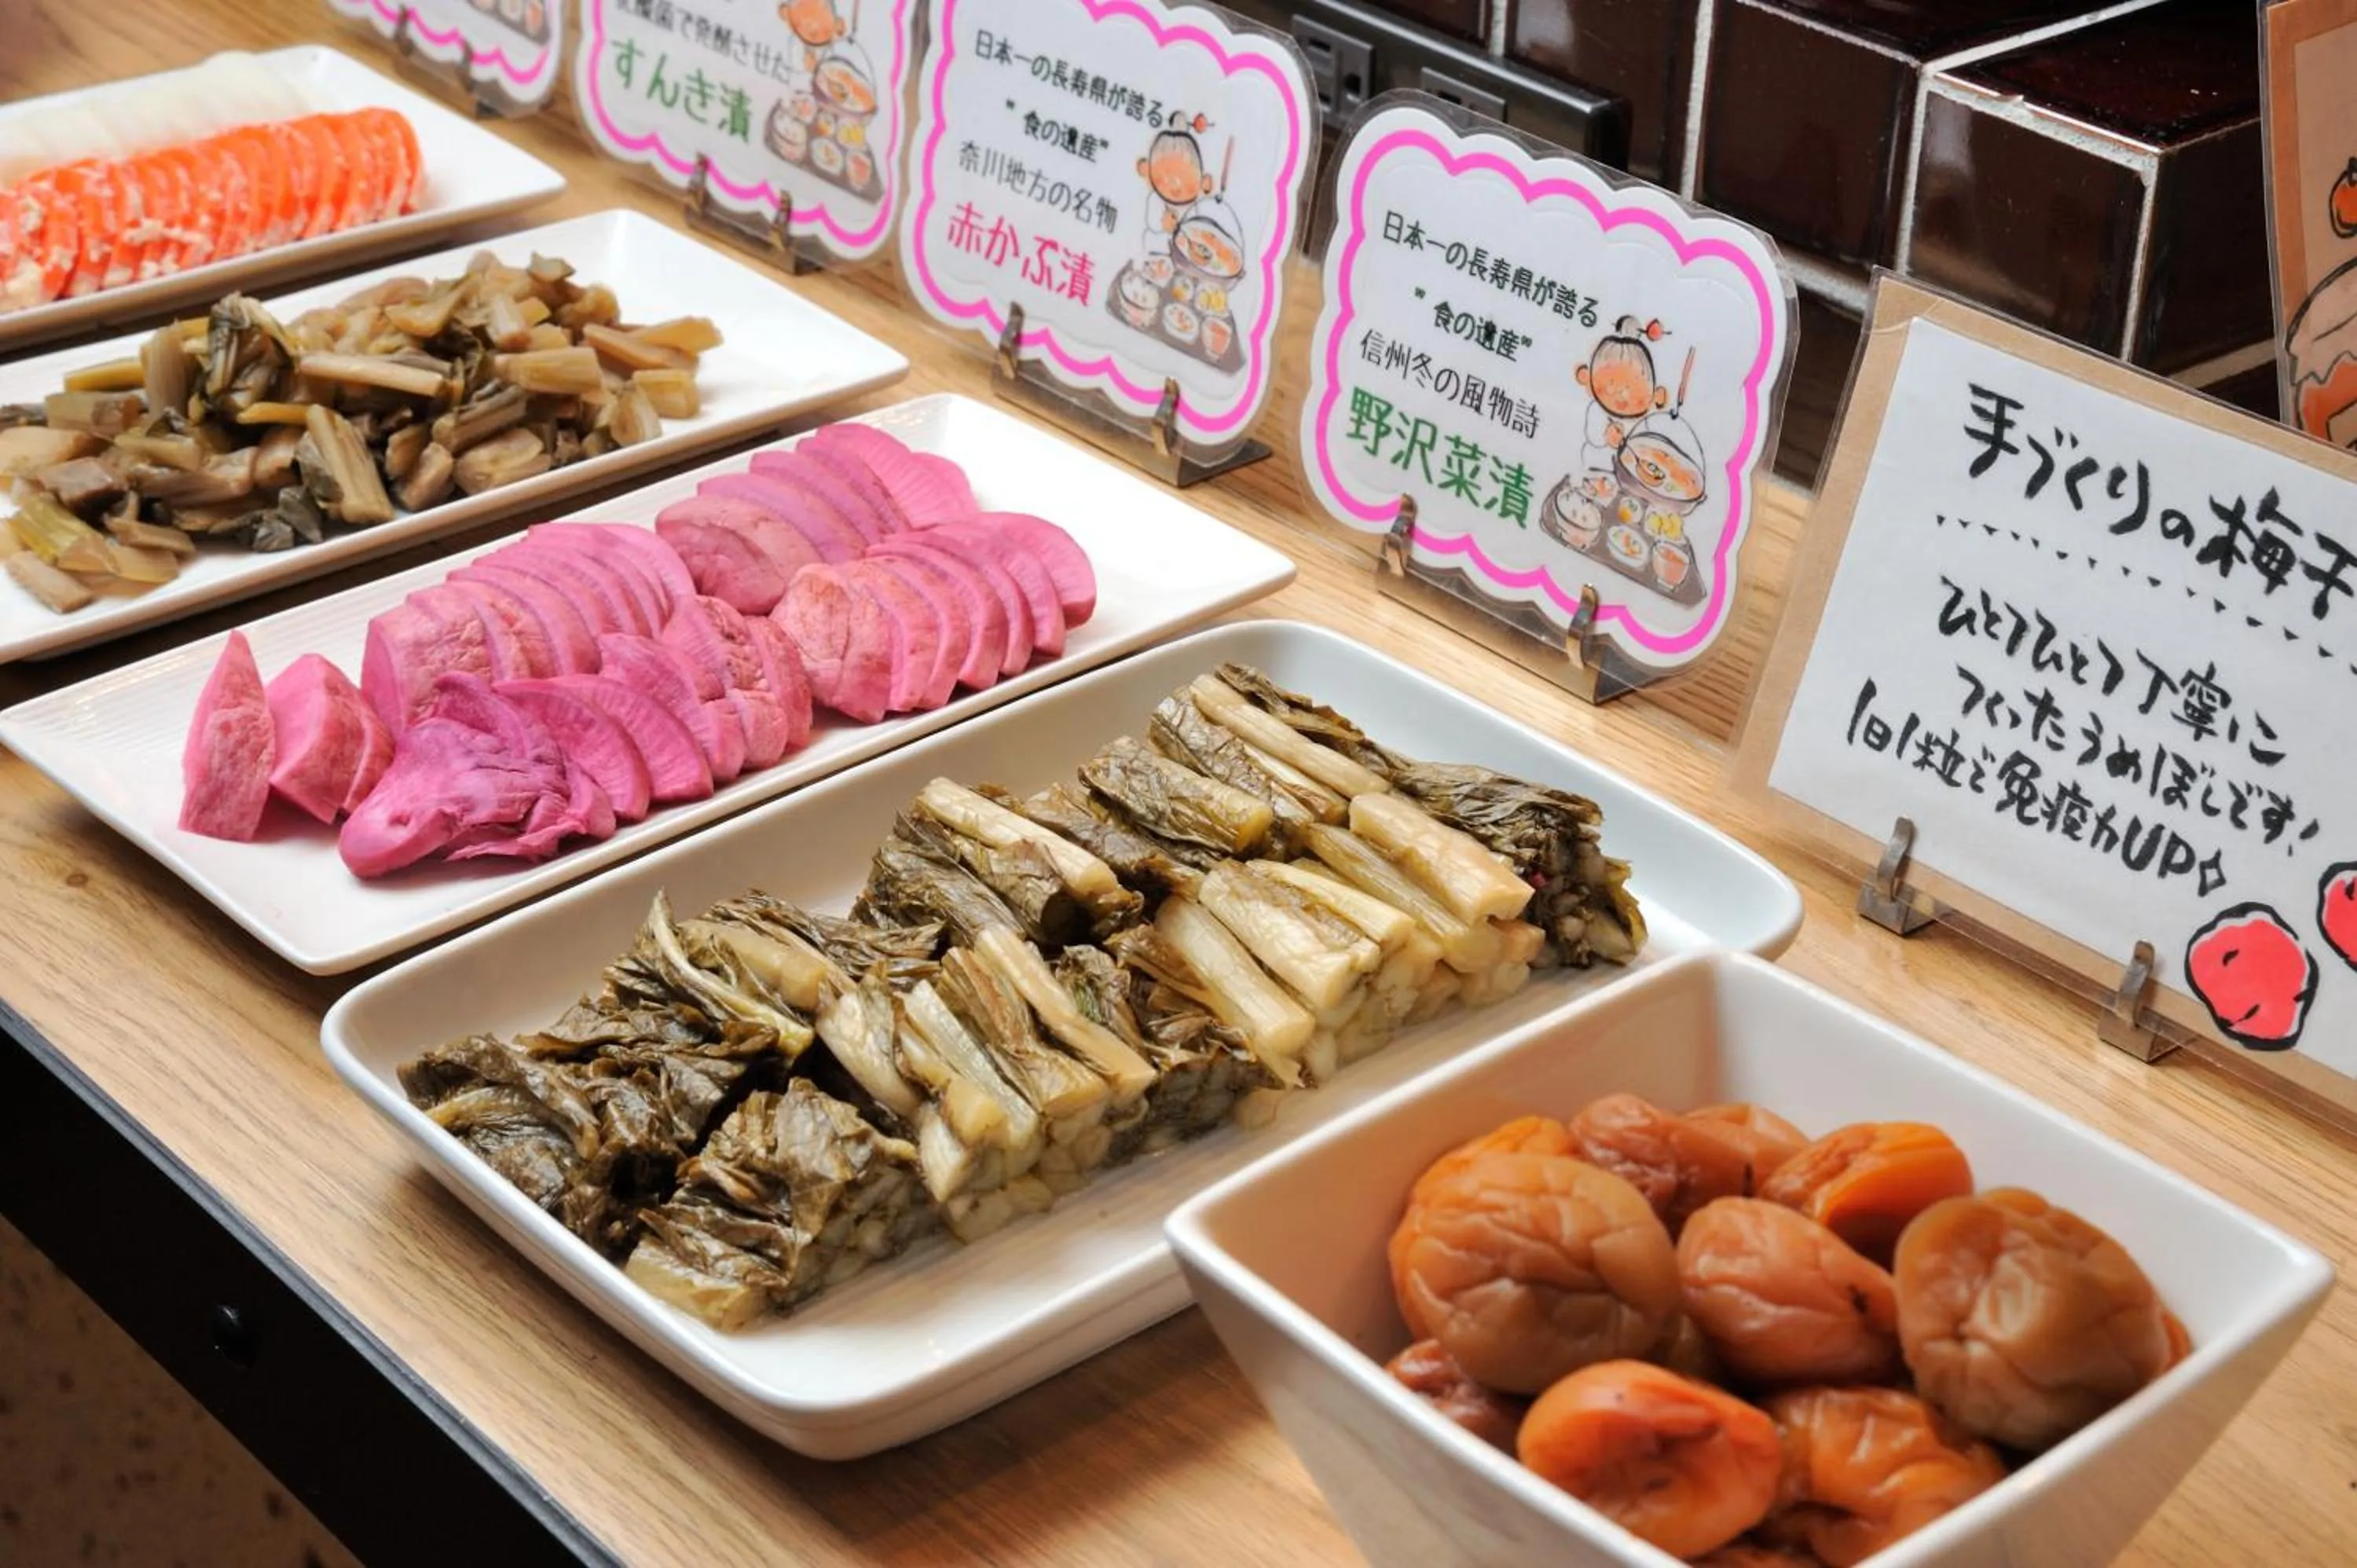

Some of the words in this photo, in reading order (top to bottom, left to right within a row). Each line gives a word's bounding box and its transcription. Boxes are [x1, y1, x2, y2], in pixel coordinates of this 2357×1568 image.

[611, 39, 752, 144] すんき漬
[975, 30, 1163, 129] 日本一の長寿県が誇る
[959, 139, 1118, 234] 奈川地方の名物
[948, 201, 1094, 307] 赤かぶ漬
[1384, 211, 1599, 328] 日本一の長寿県が誇る
[1359, 328, 1541, 441] 信州冬の風物詩
[1346, 387, 1534, 529] 野沢菜漬
[1937, 575, 2286, 767] ひとつひとつ丁寧に
